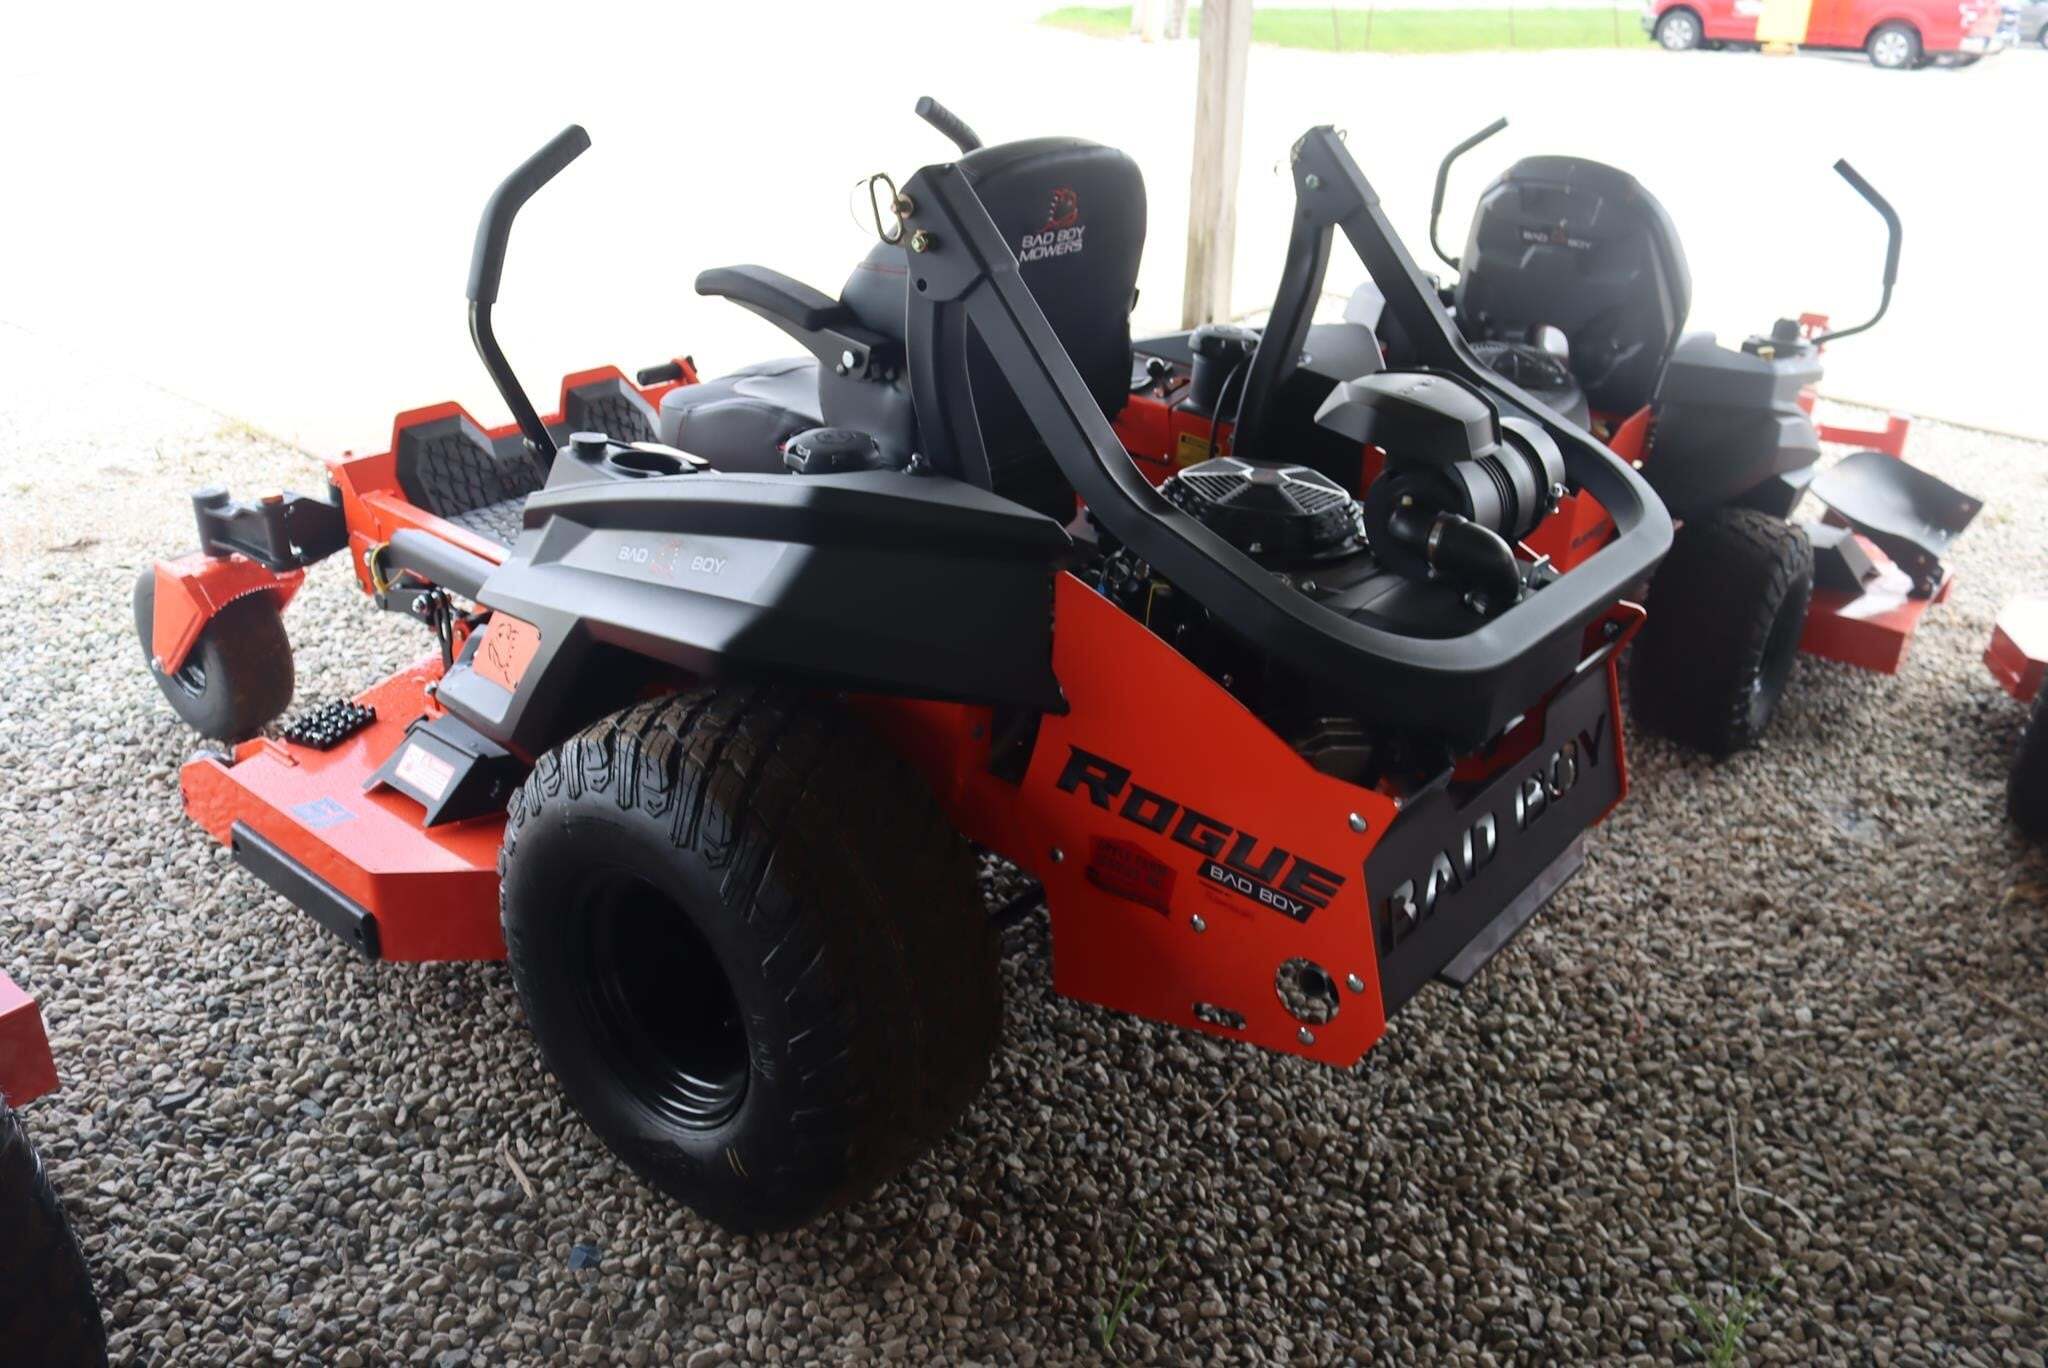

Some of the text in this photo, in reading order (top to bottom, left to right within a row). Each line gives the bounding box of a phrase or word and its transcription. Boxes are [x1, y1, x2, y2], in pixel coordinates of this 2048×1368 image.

[1019, 239, 1083, 262] MOWERS
[1022, 225, 1086, 249] BAD BOY
[618, 545, 728, 574] BAD BOY
[1056, 744, 1346, 910] ROGUE
[1379, 713, 1606, 954] BAD BOY
[1210, 864, 1253, 894] BAD
[1259, 887, 1303, 915] BOY
